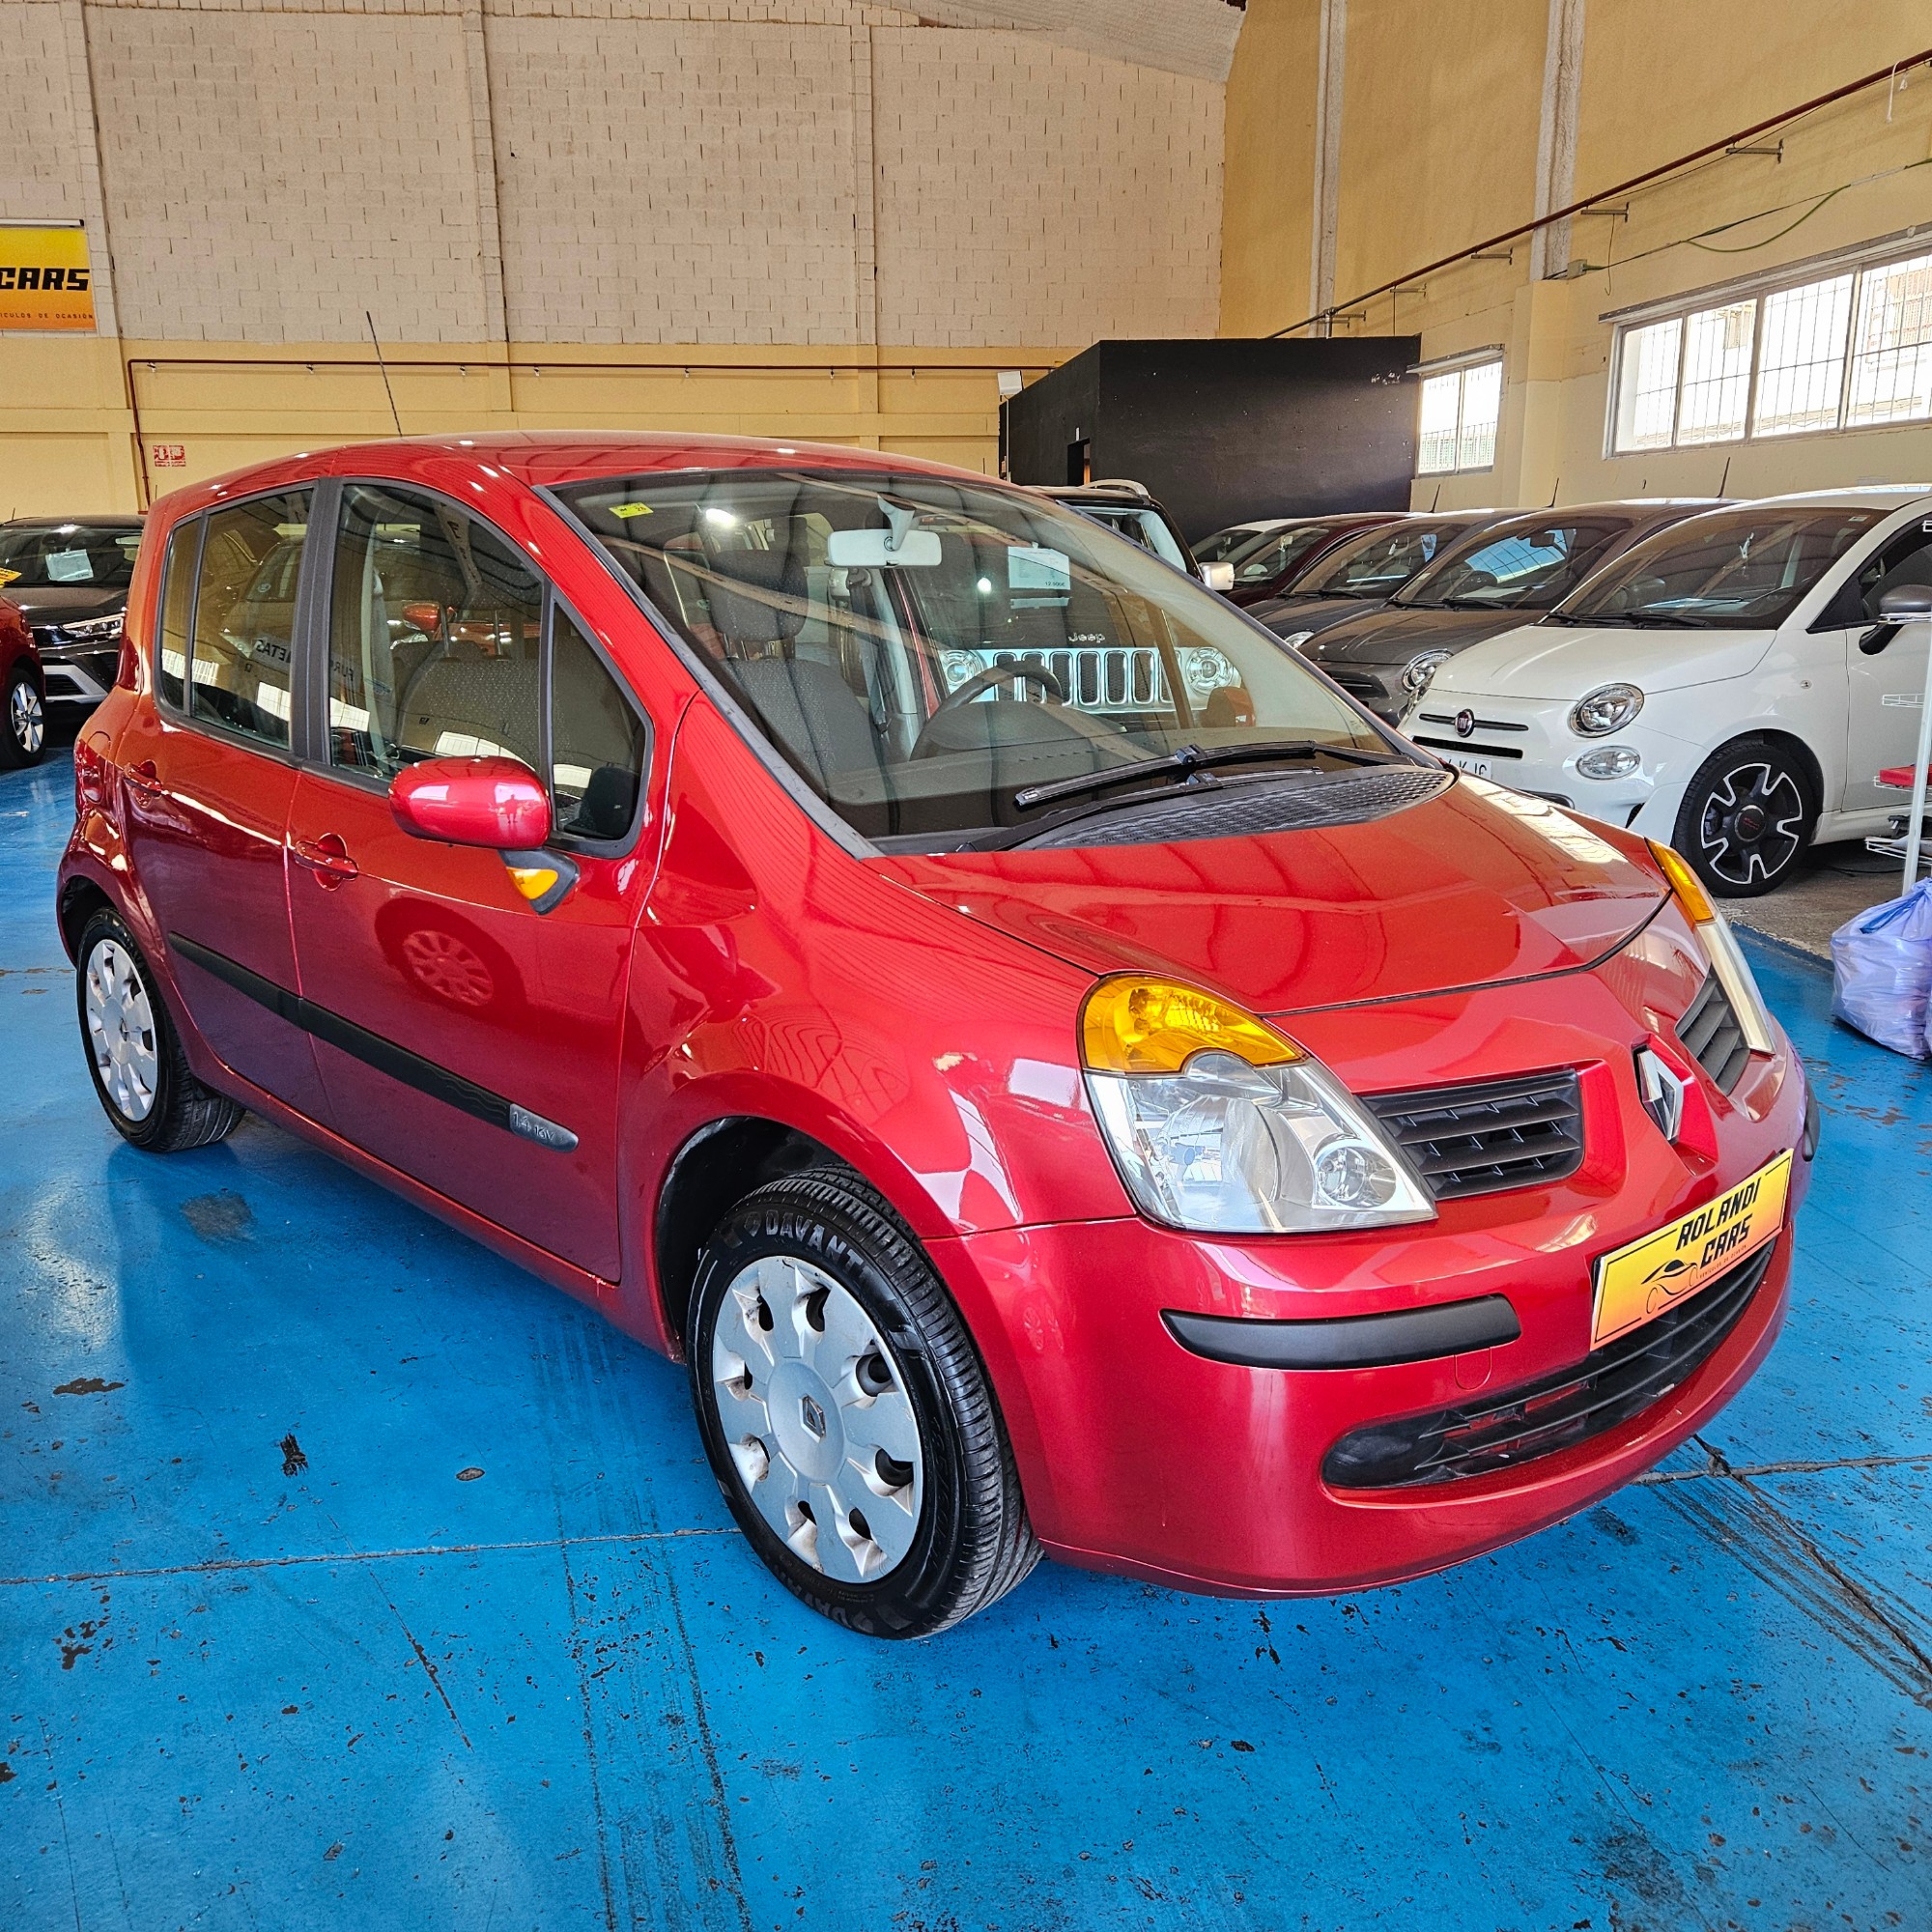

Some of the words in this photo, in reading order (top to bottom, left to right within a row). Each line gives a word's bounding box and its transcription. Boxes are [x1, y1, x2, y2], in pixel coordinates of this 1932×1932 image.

[0, 268, 90, 291] CARS
[1067, 632, 1106, 644] Jeep
[1676, 1177, 1761, 1251] ROLANDI
[1700, 1213, 1752, 1269] CARS
